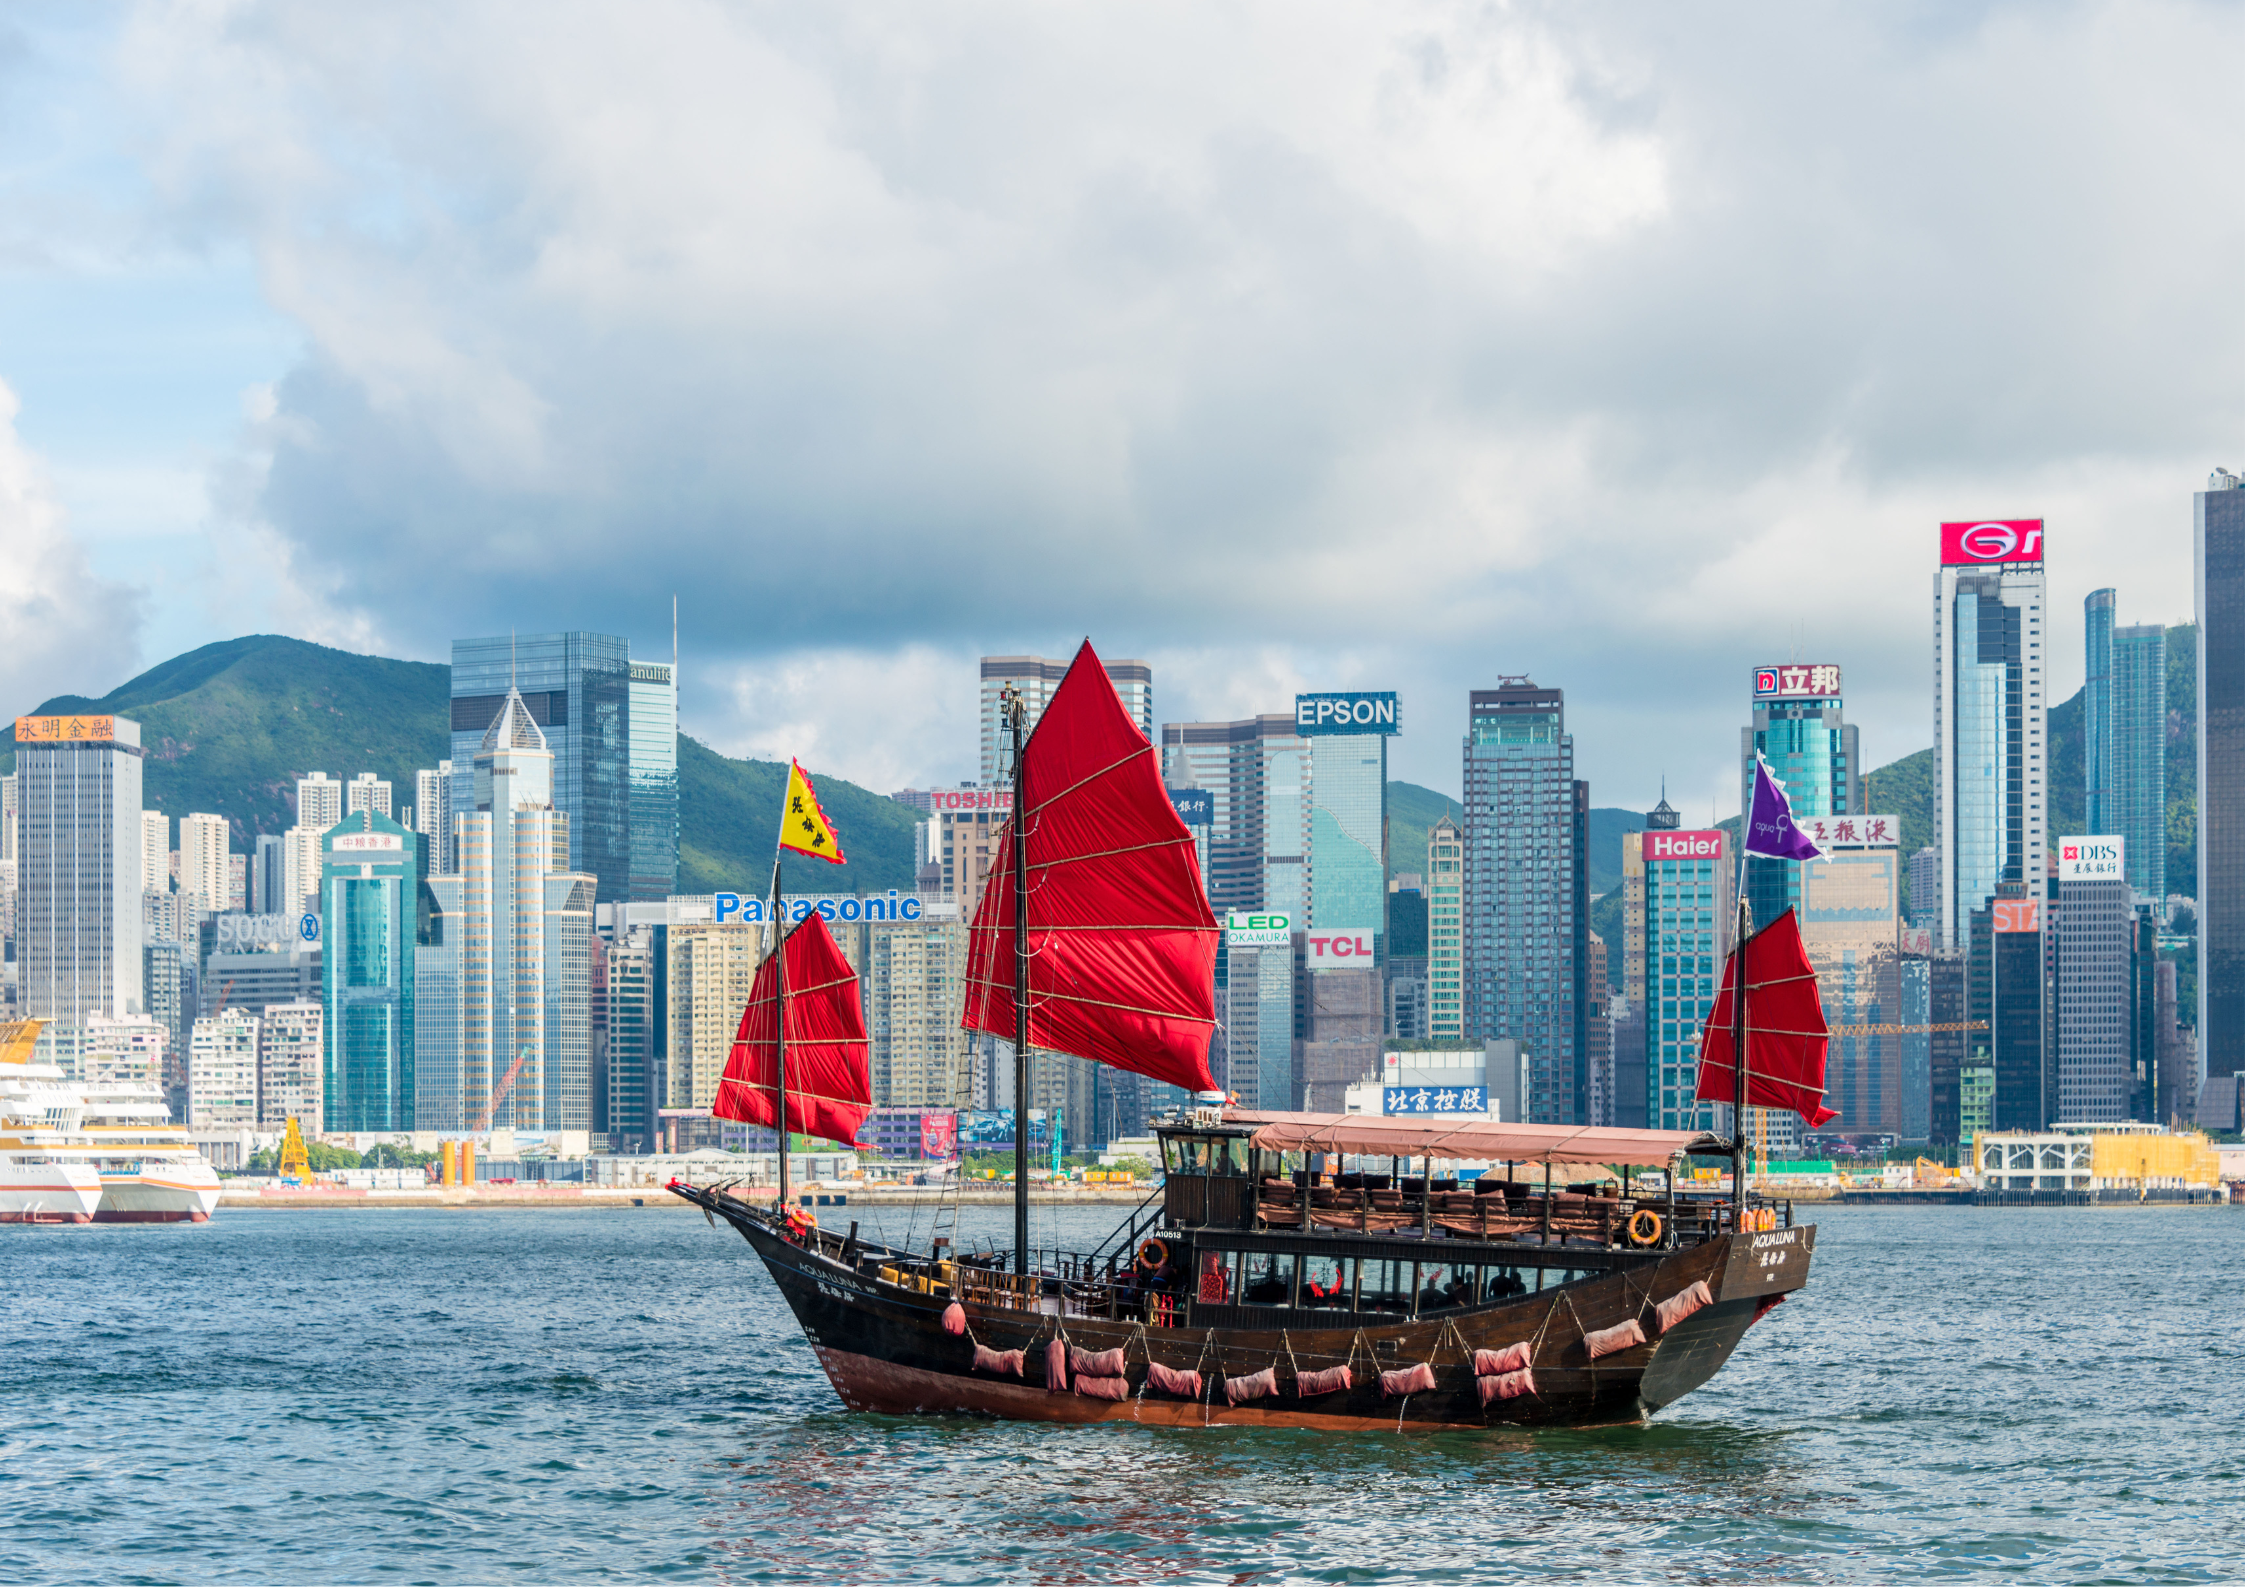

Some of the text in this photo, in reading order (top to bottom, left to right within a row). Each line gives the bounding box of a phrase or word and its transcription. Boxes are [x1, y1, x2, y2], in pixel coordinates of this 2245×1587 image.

[629, 666, 672, 681] anulife
[1781, 665, 1839, 695] 立邦
[1298, 700, 1394, 725] EPSON
[18, 718, 113, 740] 永明金融
[931, 791, 1014, 809] TOSHIB
[1755, 822, 1775, 836] aqua
[1654, 835, 1719, 856] Haier
[2081, 845, 2117, 860] DBS
[714, 889, 923, 924] Panasonic
[218, 914, 295, 942] SOGO
[1228, 916, 1289, 930] LED
[1229, 932, 1289, 943] OKAMURA
[1309, 937, 1372, 957] TCL
[1387, 1087, 1485, 1112] 北京控股
